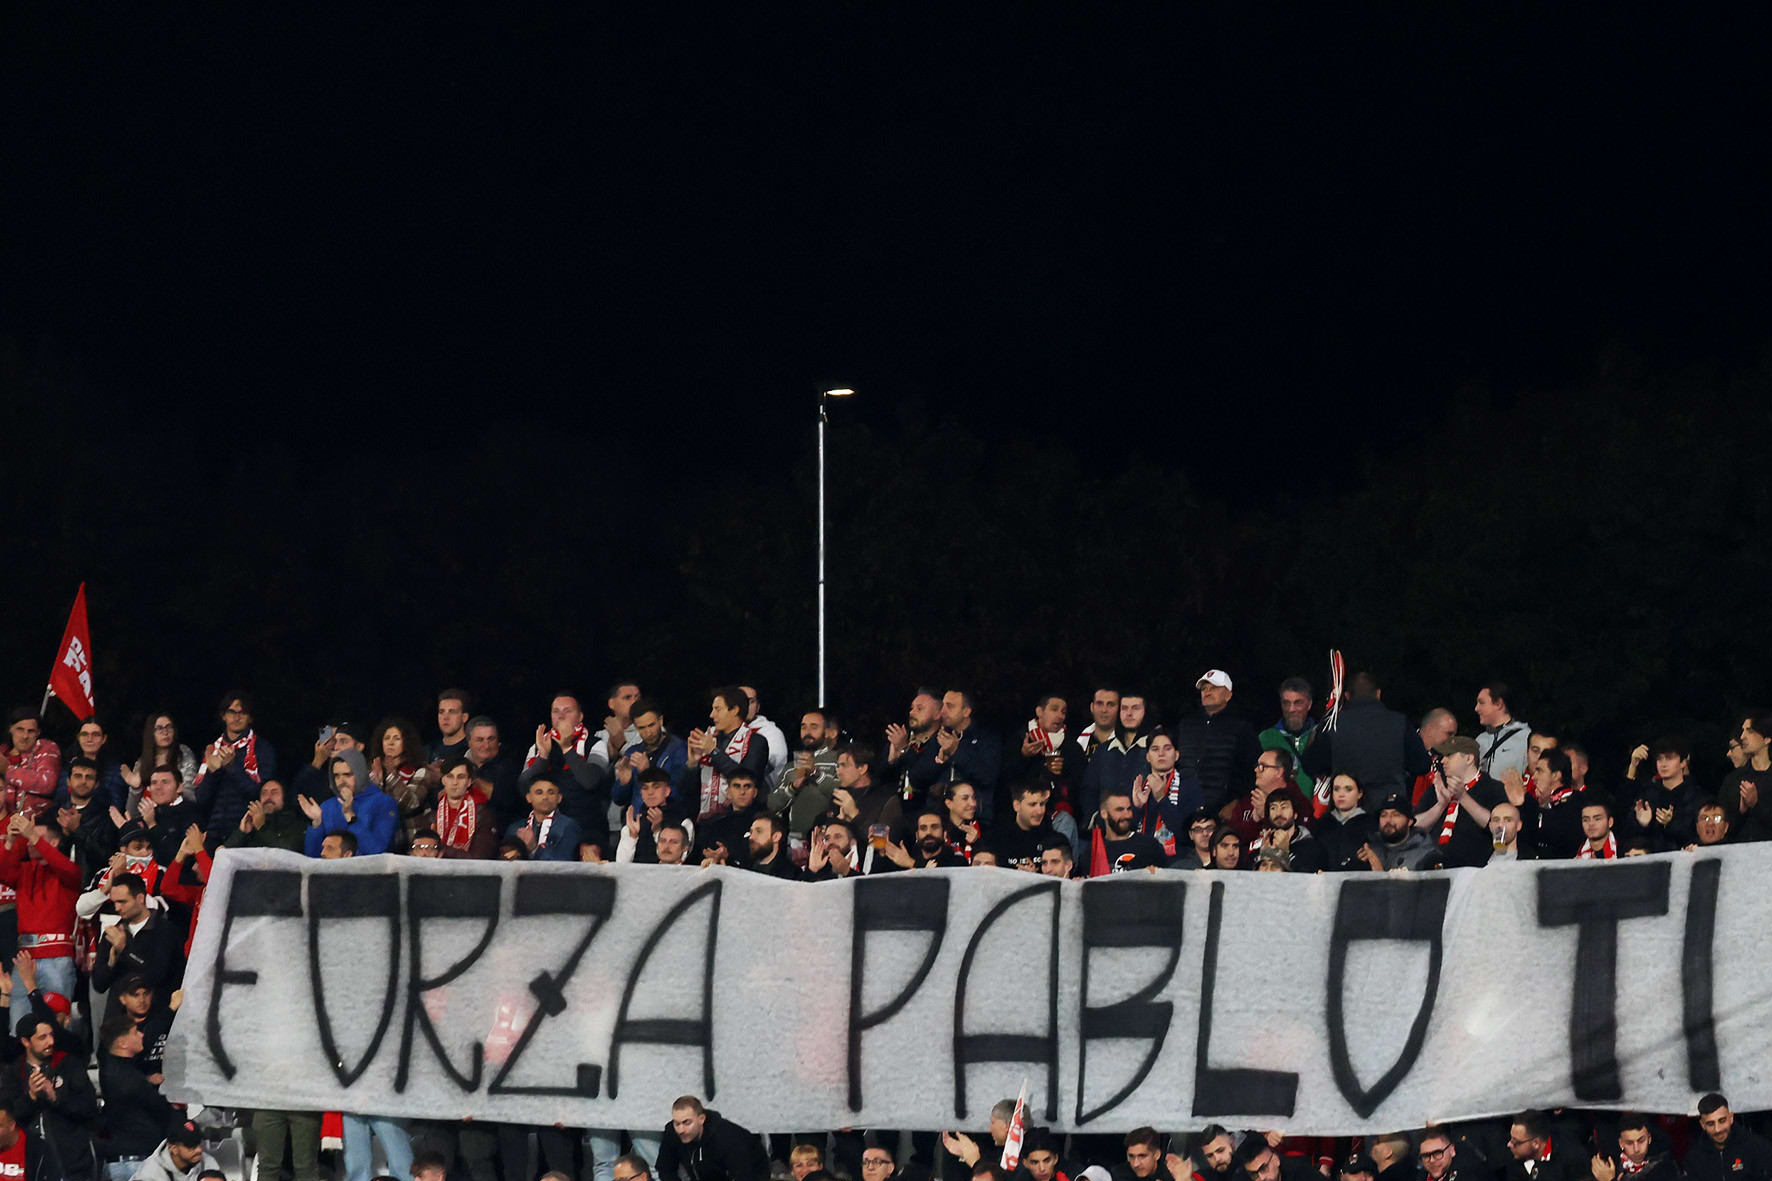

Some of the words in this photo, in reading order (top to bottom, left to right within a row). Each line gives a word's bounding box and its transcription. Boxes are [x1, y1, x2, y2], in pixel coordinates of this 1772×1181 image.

[206, 870, 722, 1102] FORZA
[847, 877, 1450, 1122] PABLO
[1536, 858, 1721, 1102] TI
